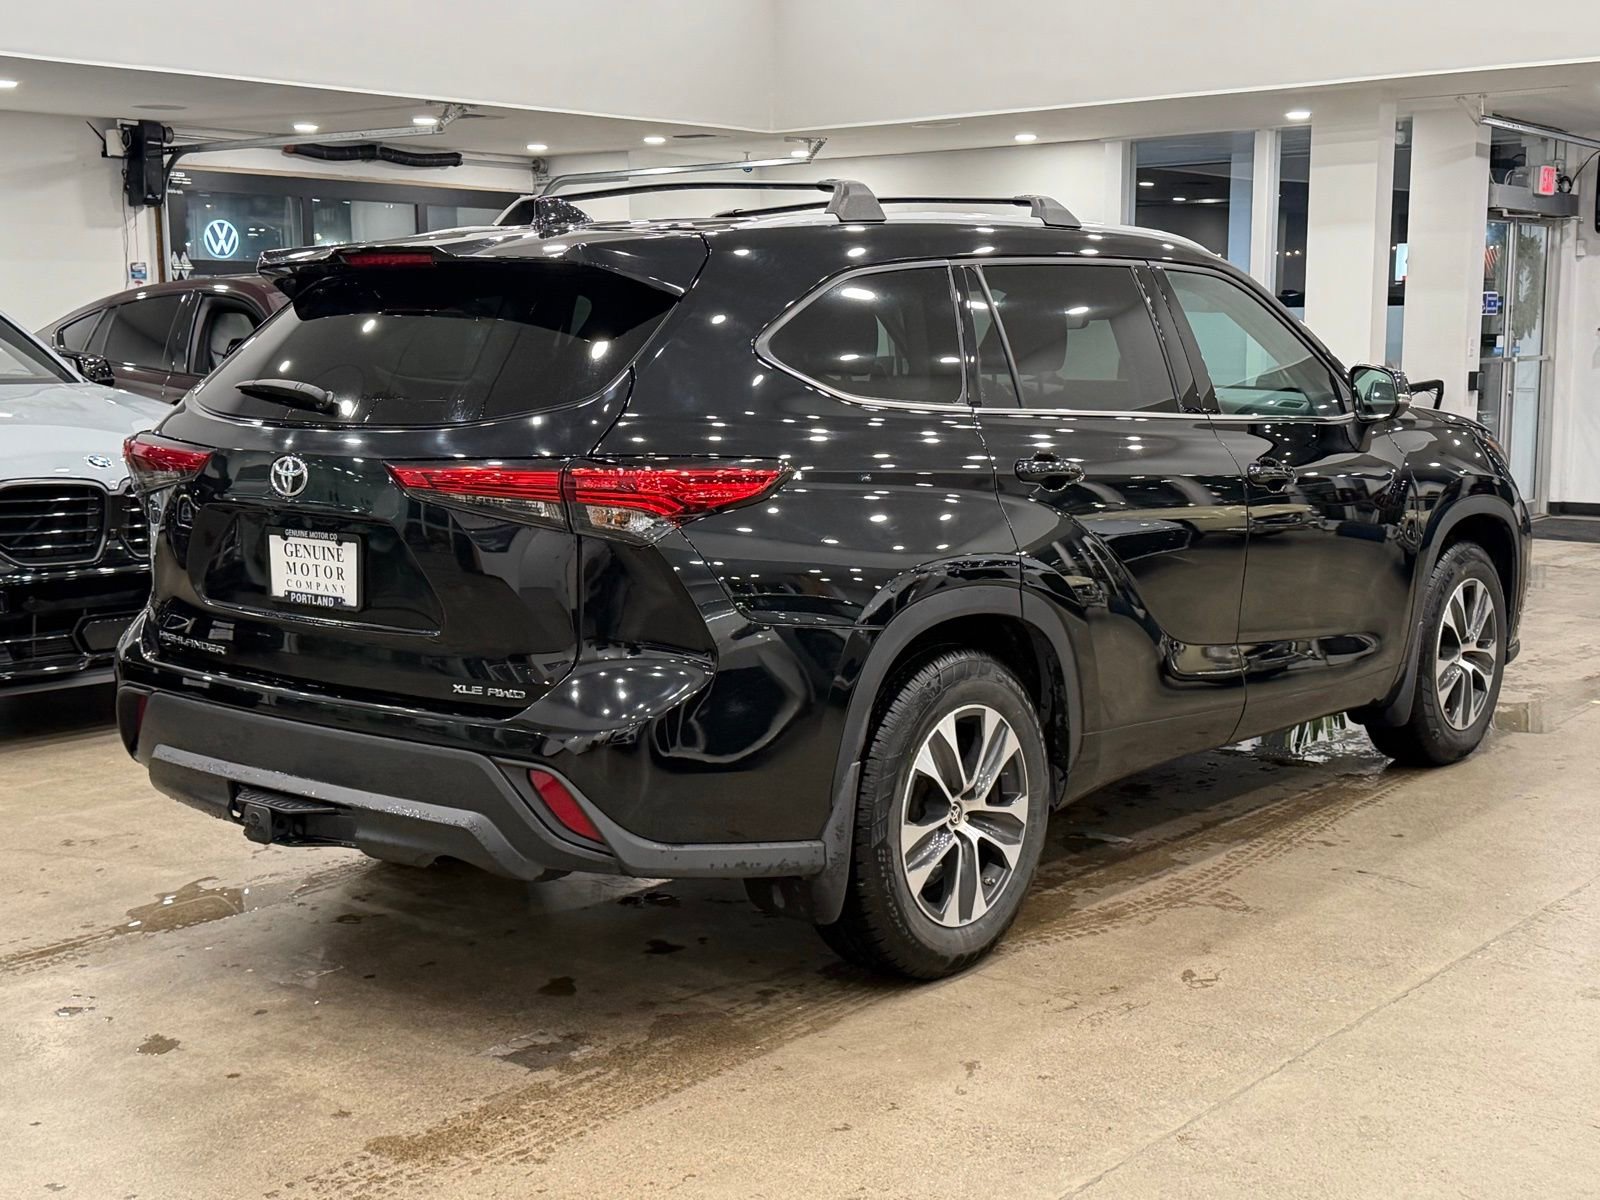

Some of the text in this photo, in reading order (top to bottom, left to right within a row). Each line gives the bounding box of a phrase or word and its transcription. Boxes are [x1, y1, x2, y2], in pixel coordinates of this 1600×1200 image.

[284, 528, 338, 541] GENUINE MOTOR CO
[283, 542, 344, 563] GENUINE
[285, 561, 344, 581] MOTOR
[286, 579, 346, 594] COMPANY
[290, 592, 334, 607] PORTLAND
[452, 683, 483, 695] XLE
